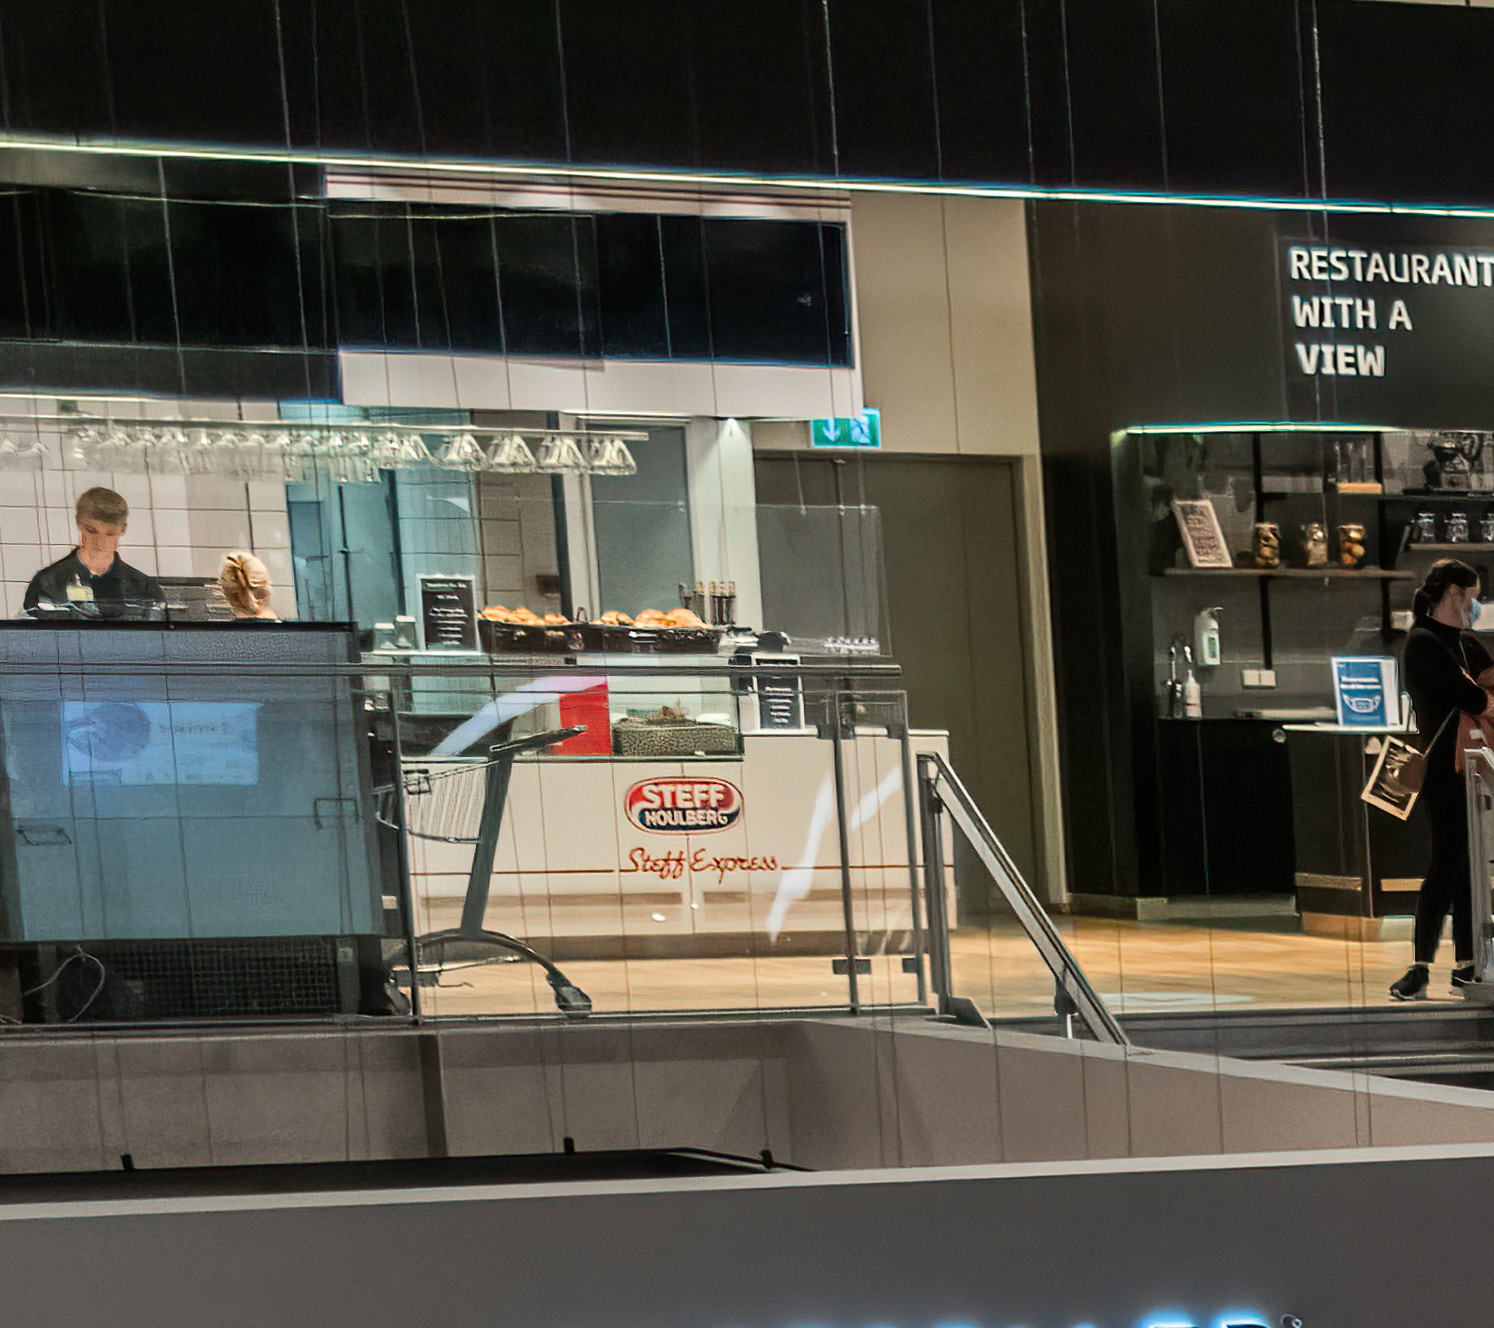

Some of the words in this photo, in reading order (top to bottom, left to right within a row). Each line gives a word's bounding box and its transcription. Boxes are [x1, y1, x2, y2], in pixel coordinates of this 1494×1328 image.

[1294, 296, 1377, 330] WITH
[1389, 300, 1414, 331] A
[1295, 342, 1386, 378] VIEW
[641, 783, 725, 809] STEFF
[689, 848, 778, 884] Express
